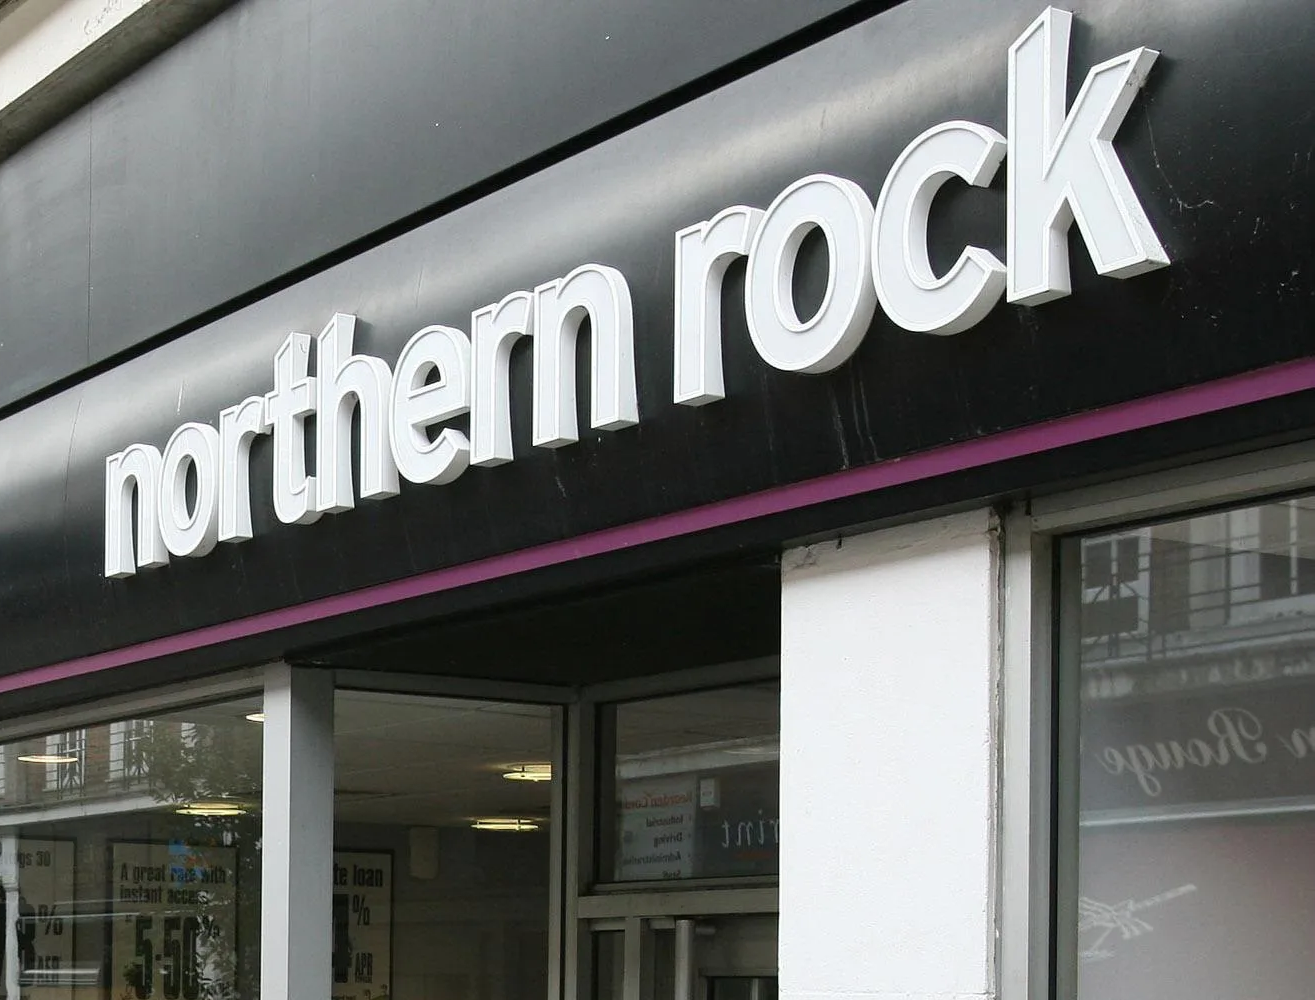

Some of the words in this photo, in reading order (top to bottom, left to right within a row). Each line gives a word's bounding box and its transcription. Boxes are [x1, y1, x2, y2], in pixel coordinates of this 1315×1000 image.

[103, 312, 639, 579] northern
[673, 5, 1171, 408] rock
[121, 863, 128, 881] A
[133, 864, 166, 884] great
[353, 863, 384, 887] loan
[121, 885, 162, 903] instant
[355, 952, 373, 976] APR
